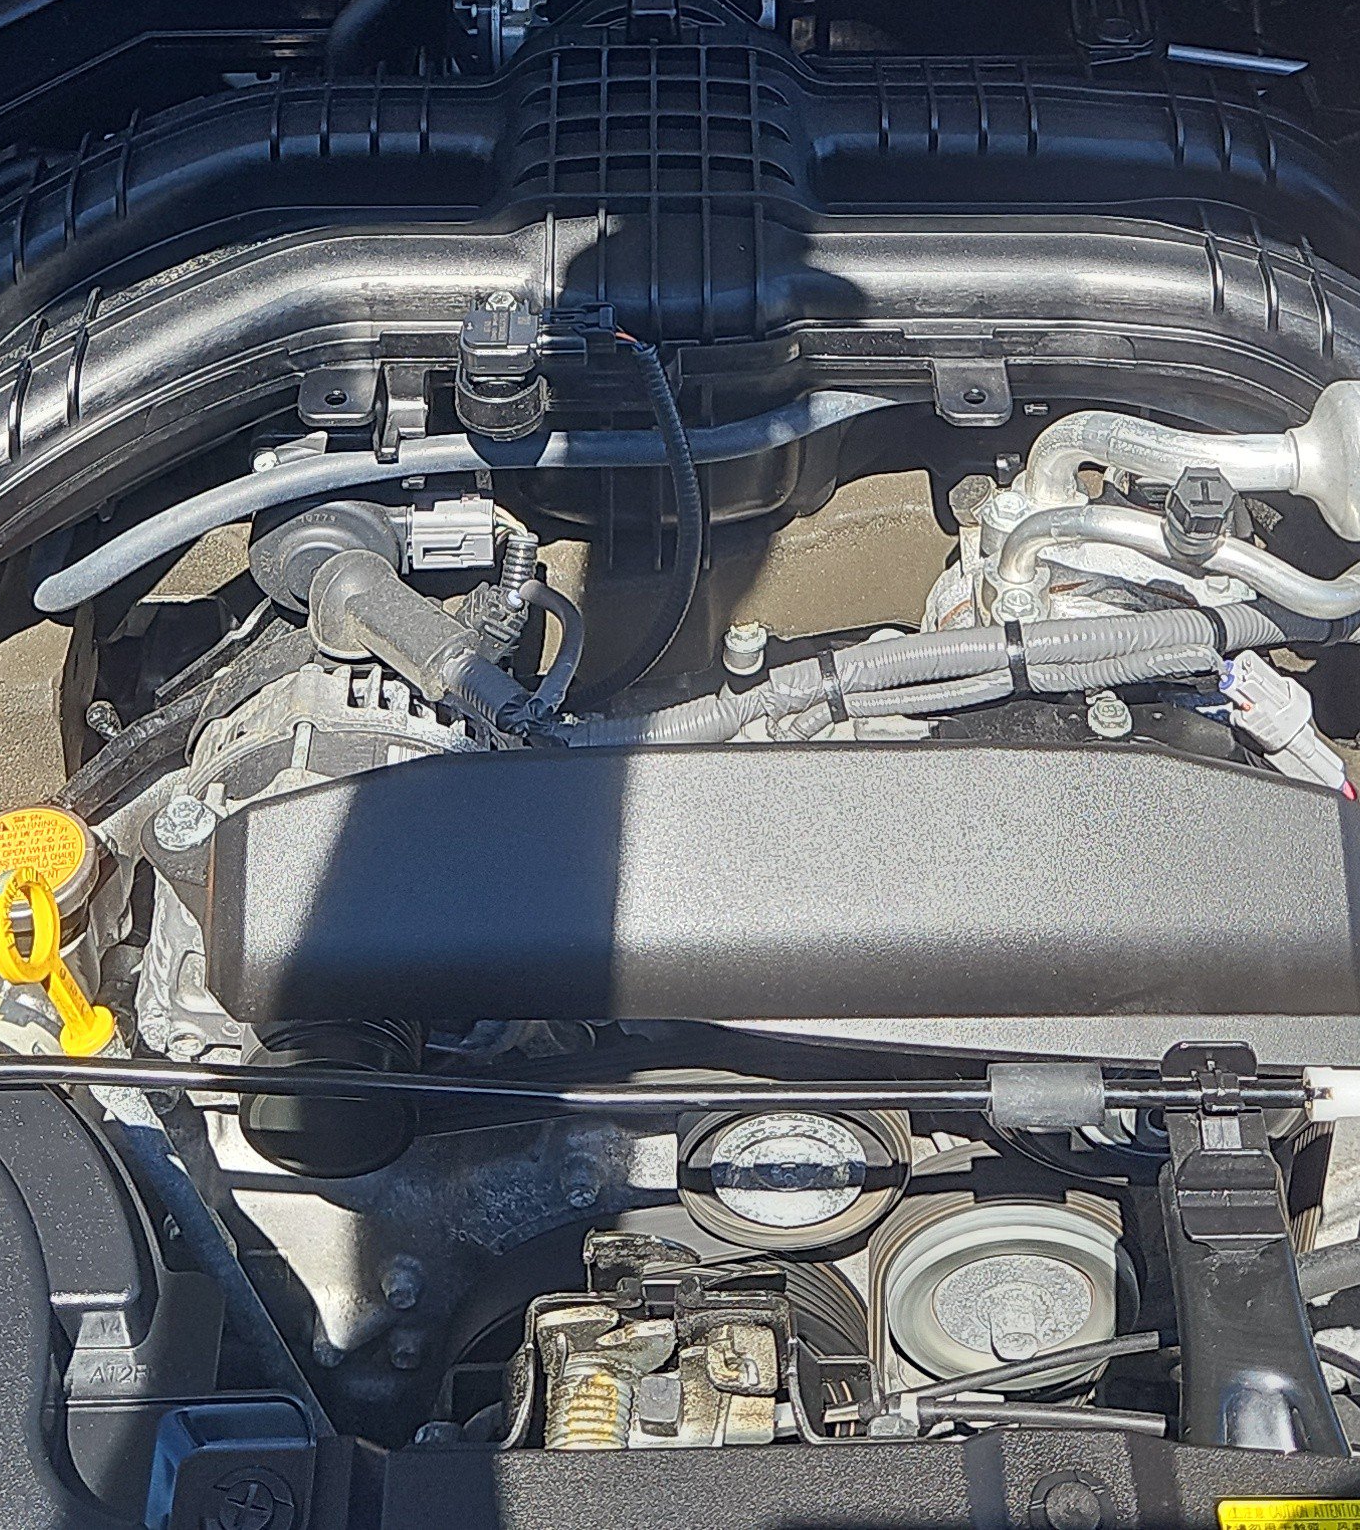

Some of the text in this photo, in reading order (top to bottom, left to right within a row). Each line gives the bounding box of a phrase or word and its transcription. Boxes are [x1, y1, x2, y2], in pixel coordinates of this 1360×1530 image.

[11, 819, 58, 831] WARNING
[2, 848, 26, 858] OPEN
[28, 844, 56, 854] WHEN
[1268, 1503, 1309, 1519] CAUTION
